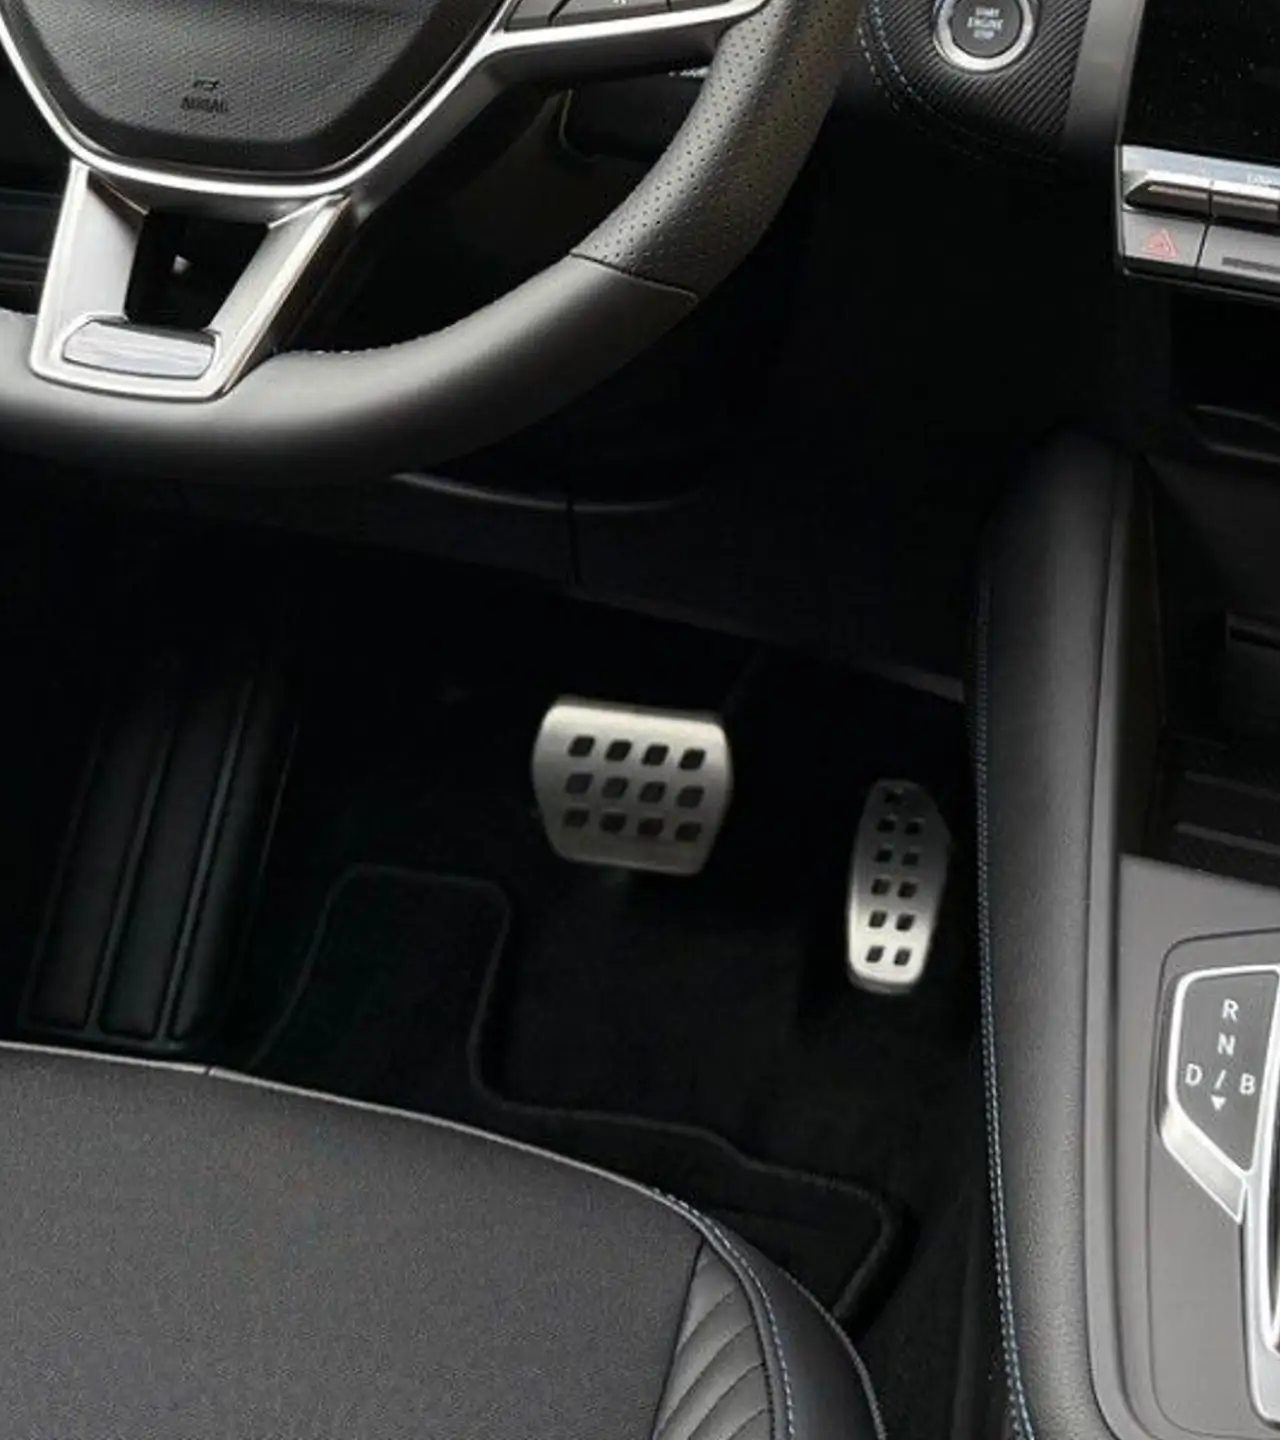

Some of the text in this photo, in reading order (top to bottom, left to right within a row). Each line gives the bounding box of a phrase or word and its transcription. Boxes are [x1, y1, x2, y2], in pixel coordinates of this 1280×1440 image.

[1222, 998, 1239, 1022] R
[1217, 1032, 1236, 1056] N
[1185, 1063, 1203, 1087] D
[1239, 1072, 1256, 1096] B
